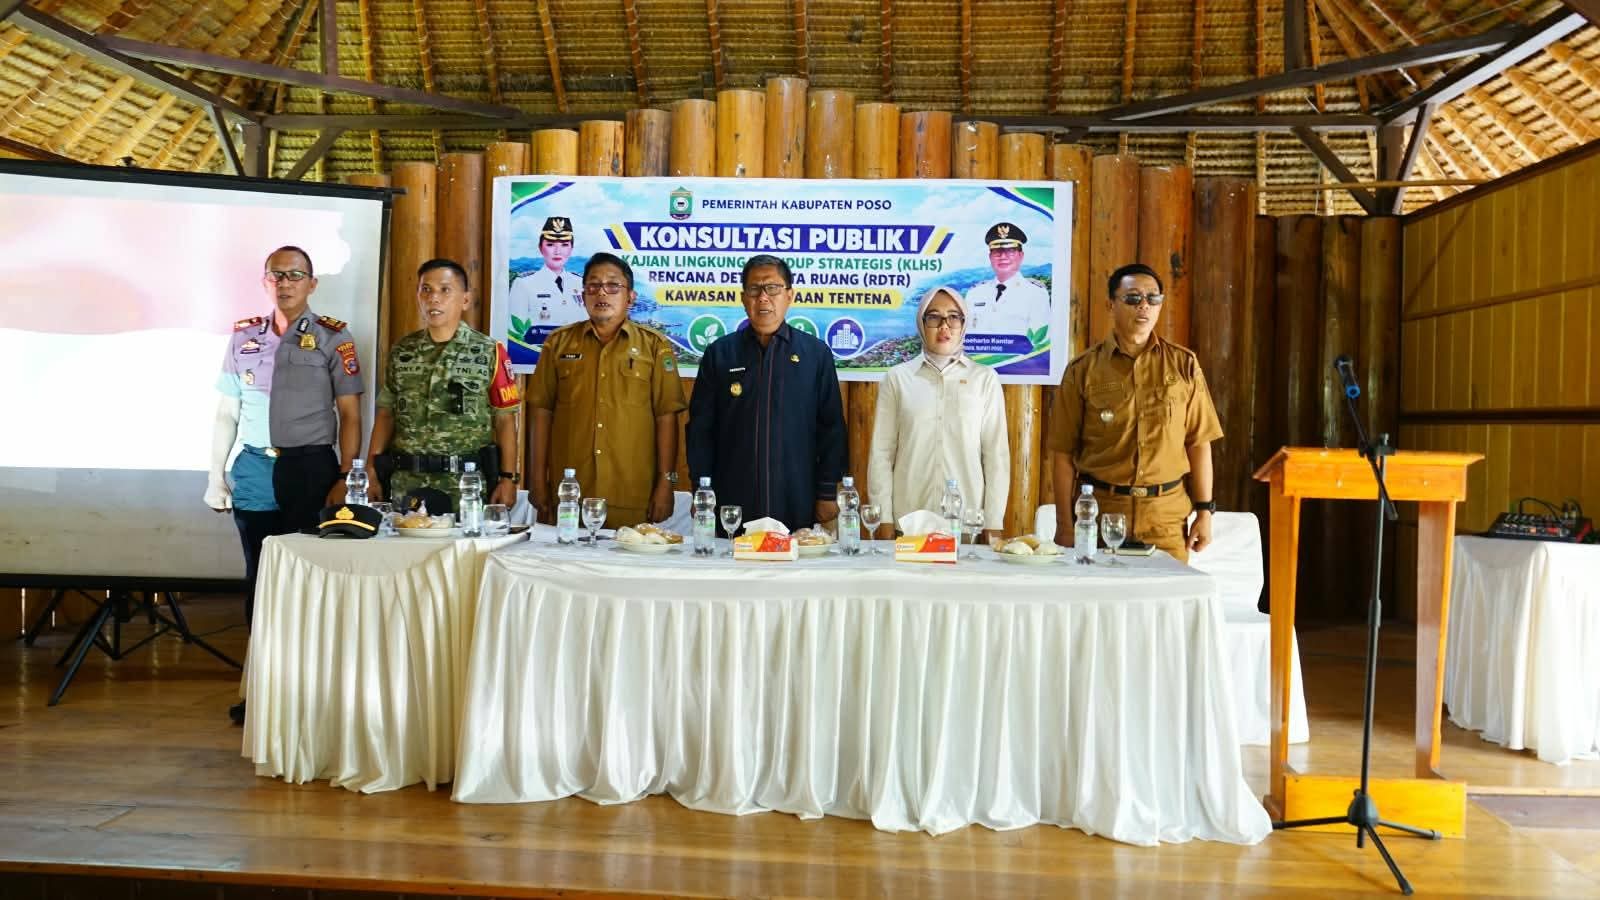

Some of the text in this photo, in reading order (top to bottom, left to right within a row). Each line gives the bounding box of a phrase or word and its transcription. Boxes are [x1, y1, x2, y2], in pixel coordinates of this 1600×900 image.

[702, 199, 892, 210] PEMERINTAH KABUPATEN POSO
[640, 226, 919, 251] KONSULTASI PUBLIK I
[675, 256, 747, 268] LINGKUNG
[818, 257, 893, 270] STRATEGIS
[897, 257, 942, 272] (KLHS)
[648, 271, 716, 283] RENCANA
[810, 273, 859, 285] RUANG
[863, 272, 911, 288] (RDTR)
[665, 290, 736, 302] KAWASAN
[829, 292, 892, 304] TENTENA
[455, 367, 472, 375] TNI
